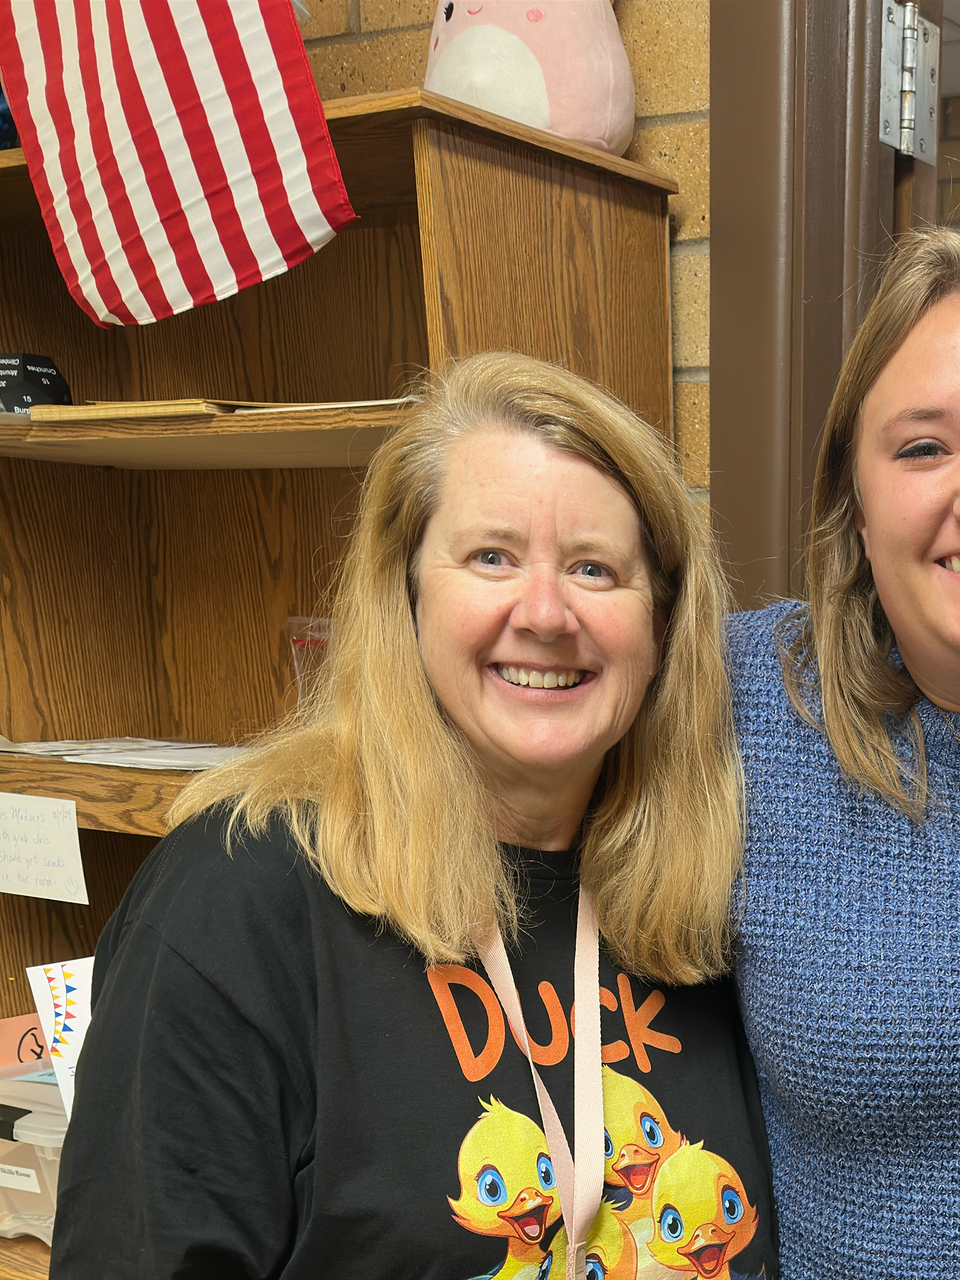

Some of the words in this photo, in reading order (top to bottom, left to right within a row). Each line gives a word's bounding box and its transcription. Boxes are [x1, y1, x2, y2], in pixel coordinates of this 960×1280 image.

[26, 364, 57, 376] Crunches
[41, 377, 50, 385] 15
[22, 395, 32, 403] 15
